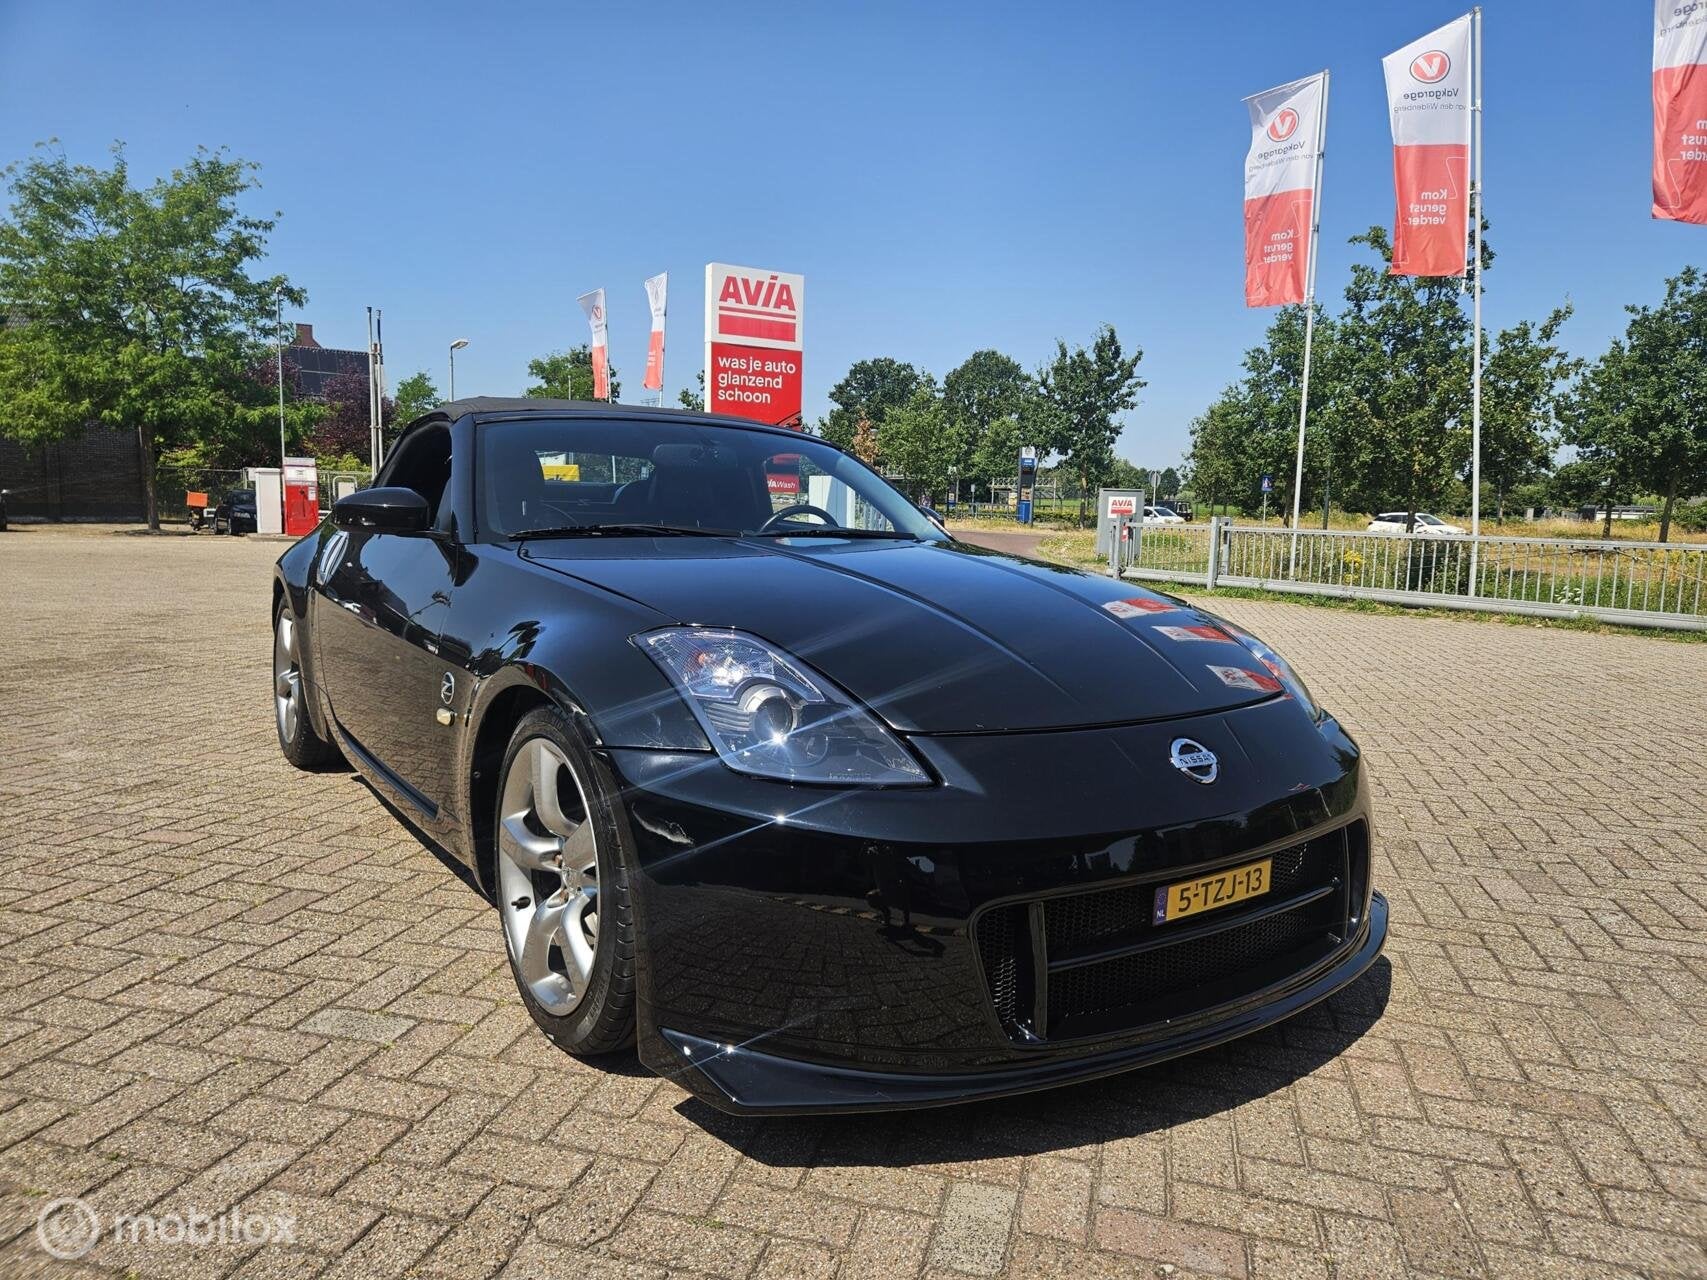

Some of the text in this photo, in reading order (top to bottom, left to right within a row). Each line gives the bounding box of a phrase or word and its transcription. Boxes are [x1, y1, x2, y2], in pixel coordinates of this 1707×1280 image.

[718, 356, 796, 374] was je auto
[718, 370, 783, 390] glanzend
[717, 387, 771, 404] schoon
[1111, 499, 1133, 507] AVIA
[1179, 752, 1215, 766] NISSAN
[1156, 909, 1165, 918] NL
